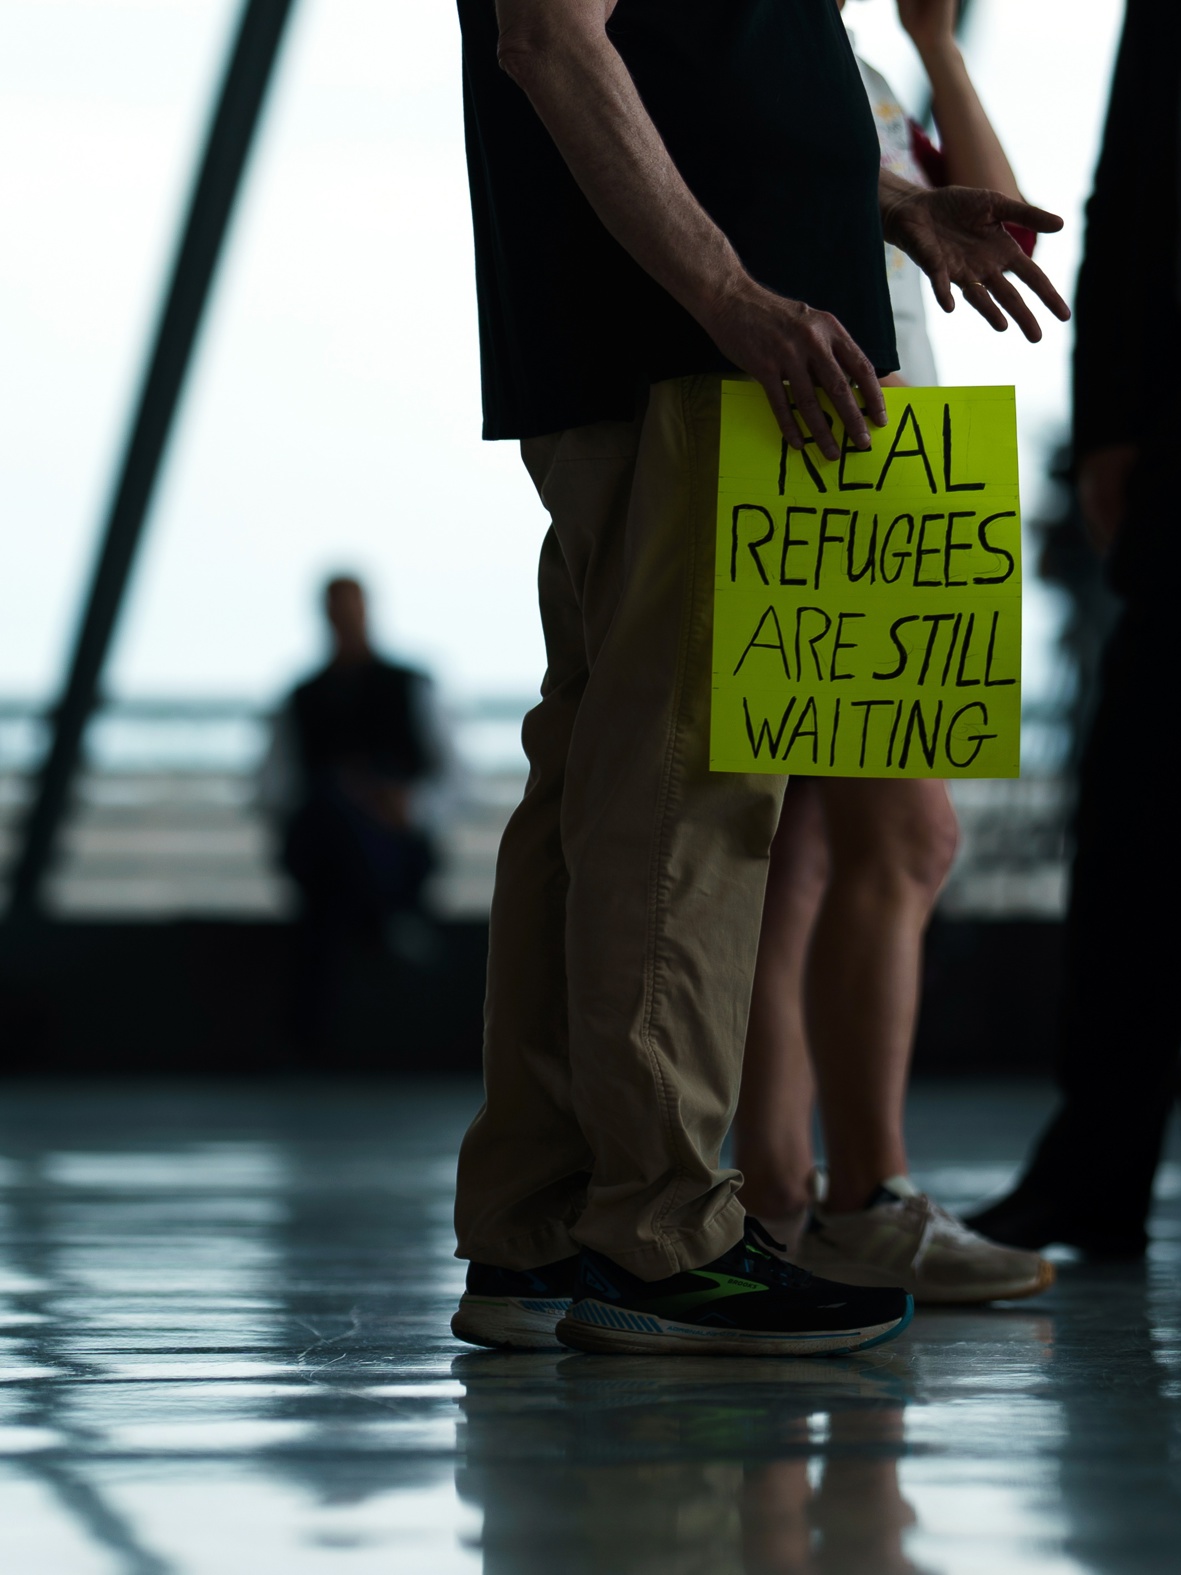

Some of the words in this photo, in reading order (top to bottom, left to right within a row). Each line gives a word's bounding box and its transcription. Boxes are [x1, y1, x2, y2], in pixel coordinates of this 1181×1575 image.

[730, 503, 1017, 590] REFUGEES
[733, 604, 867, 682] ARE
[872, 610, 1017, 687] STILL
[743, 695, 999, 770] WAITING
[727, 1278, 757, 1290] BROOKS
